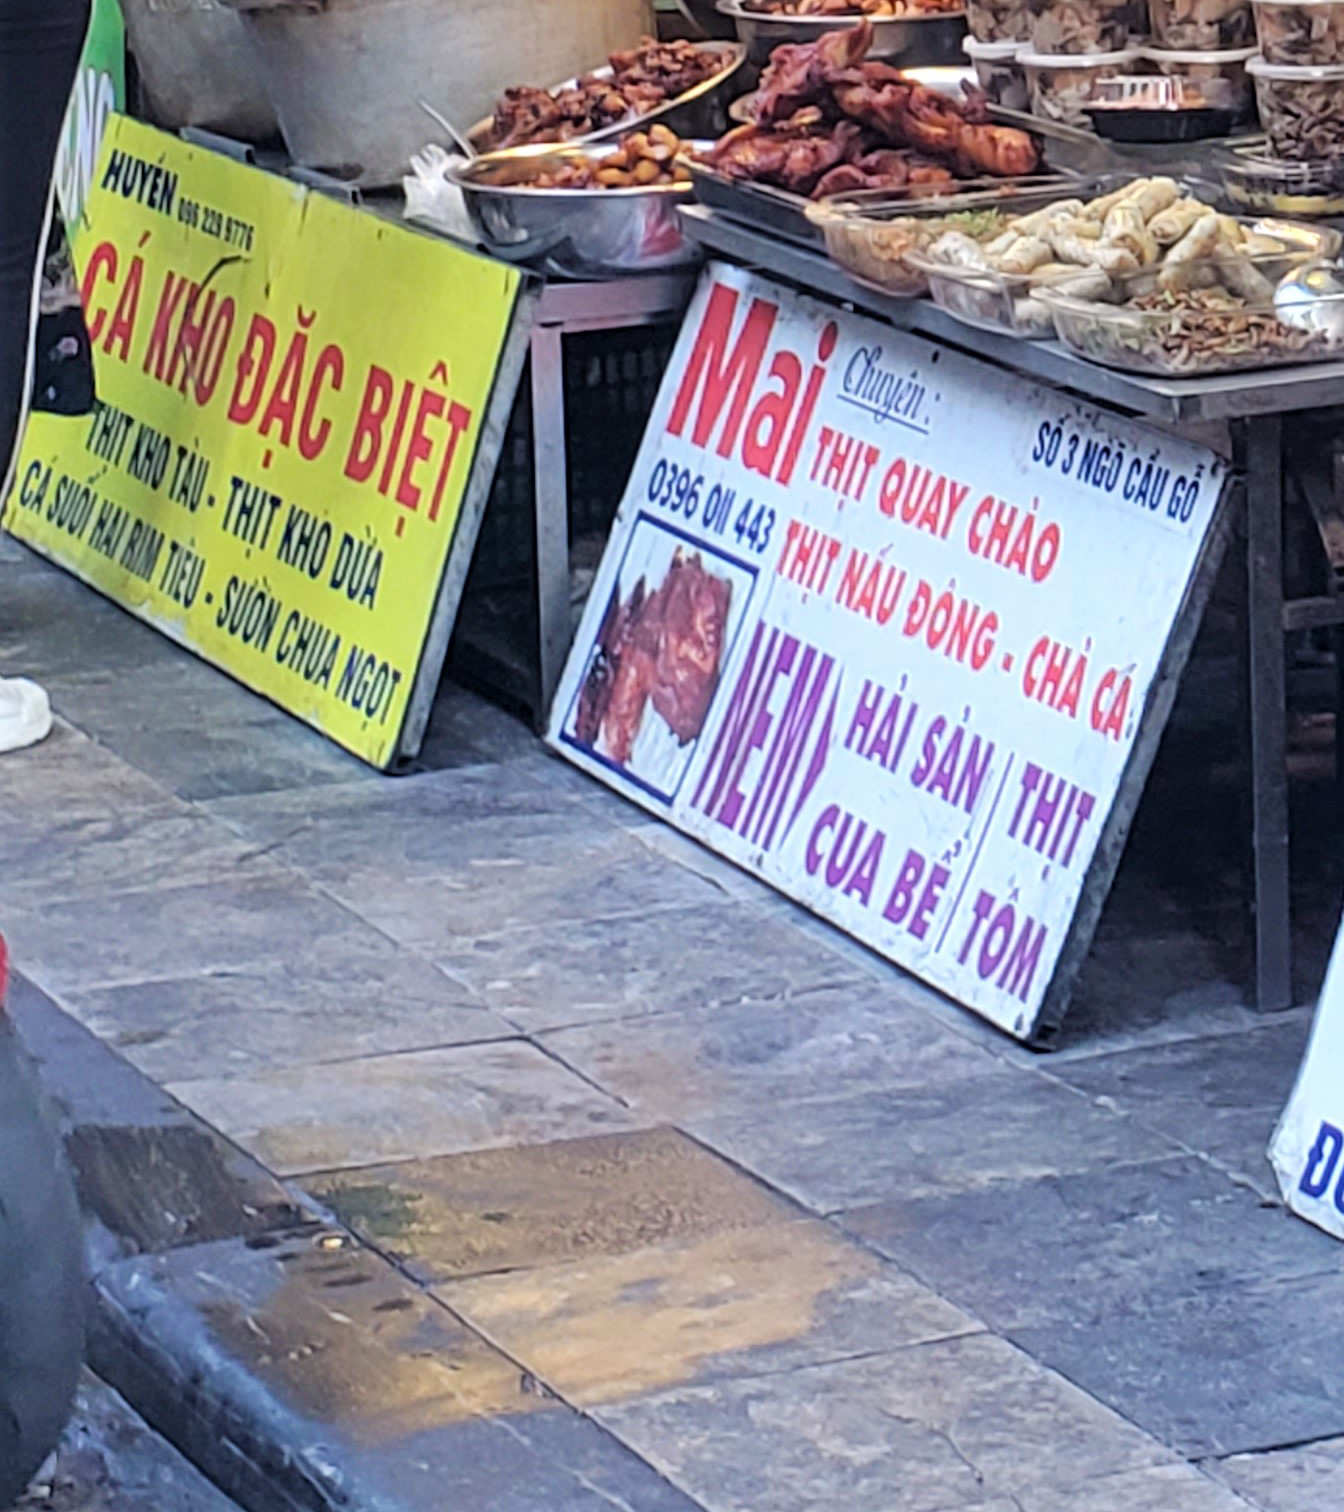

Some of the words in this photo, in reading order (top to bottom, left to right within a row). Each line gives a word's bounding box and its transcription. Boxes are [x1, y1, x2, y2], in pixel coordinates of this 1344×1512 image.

[81, 230, 152, 364] CÁ
[143, 270, 236, 406] KHO
[227, 304, 344, 469] ĐẶC
[343, 360, 472, 538] BIỆT
[666, 282, 838, 487] Mai
[1033, 414, 1070, 468] SỐ
[1061, 433, 1080, 475] 3
[127, 423, 172, 491] KHO
[222, 475, 282, 559] THỊT
[277, 504, 332, 579] KHO
[647, 458, 705, 518] 0396
[733, 498, 776, 554] 443
[810, 426, 881, 511] THỊT
[878, 456, 970, 540] QUAY
[776, 519, 843, 604] THỊT
[276, 609, 342, 691] CHUA
[335, 644, 402, 731] NGỌT
[690, 618, 836, 854] NEM
[843, 673, 918, 774] HẢI
[910, 705, 996, 815] SẢN
[1007, 761, 1097, 881] THỊT
[806, 804, 887, 908] CUA
[957, 887, 1048, 1005] TÔM
